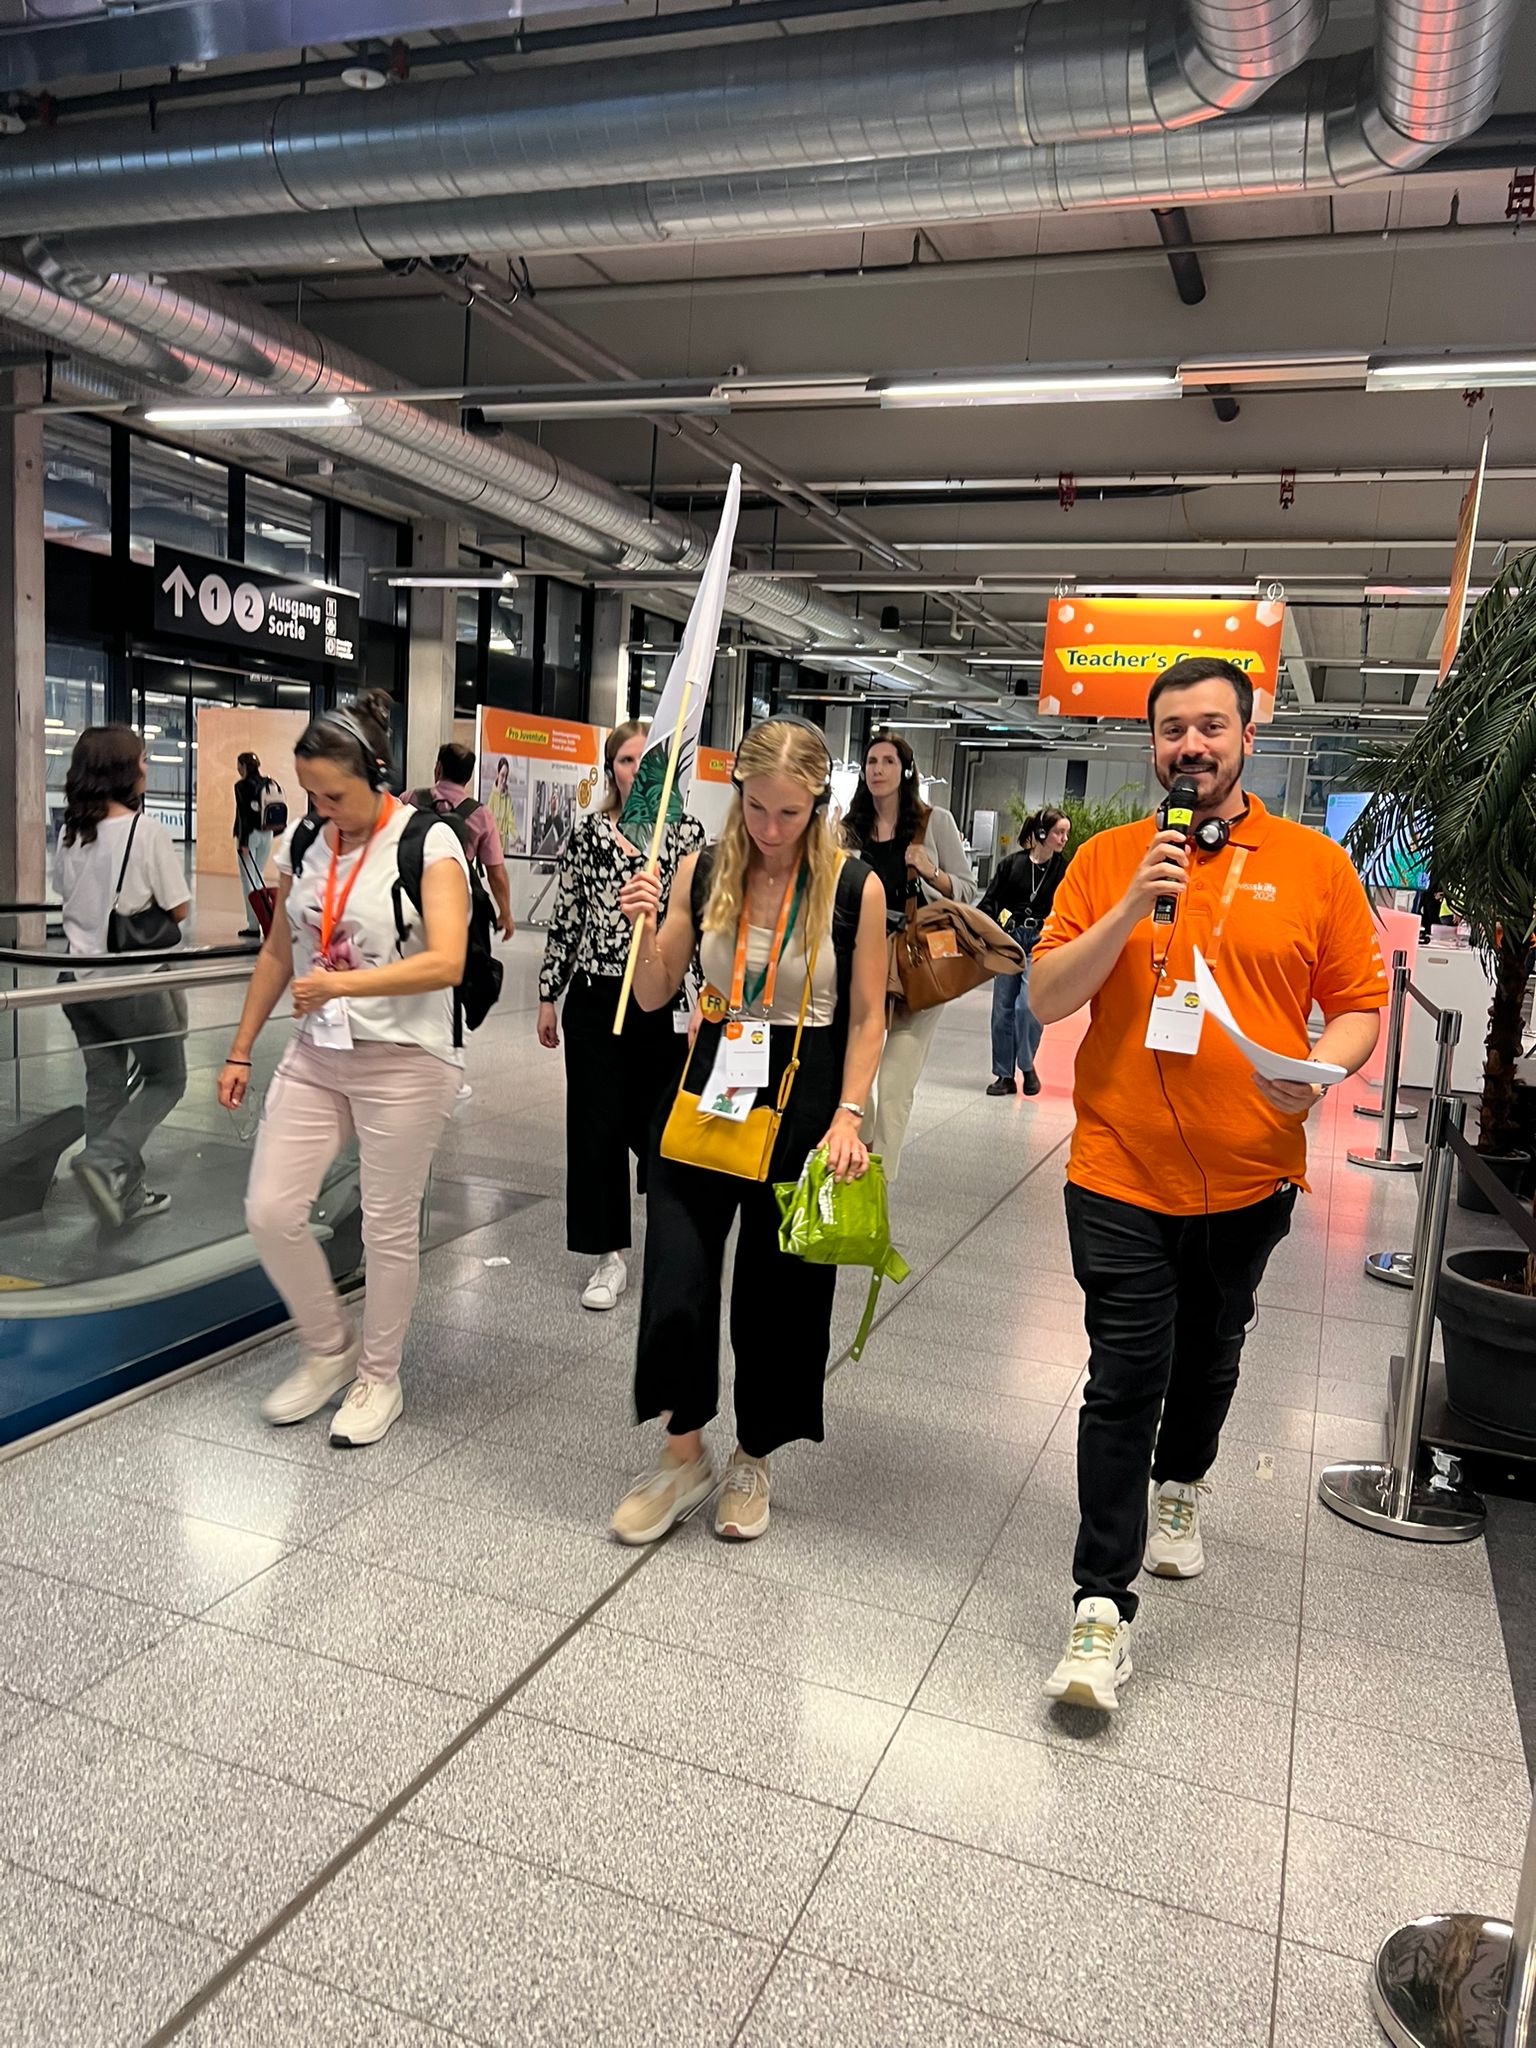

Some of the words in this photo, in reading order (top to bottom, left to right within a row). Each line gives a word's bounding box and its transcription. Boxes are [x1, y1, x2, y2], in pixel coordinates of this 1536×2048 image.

[210, 587, 218, 611] 1
[244, 595, 254, 619] 2
[268, 591, 321, 626] Ausgang
[1175, 652, 1253, 671] Cer
[508, 727, 519, 738] Pro
[1175, 810, 1183, 819] 2
[1252, 890, 1276, 902] 2025
[707, 995, 722, 1013] FR
